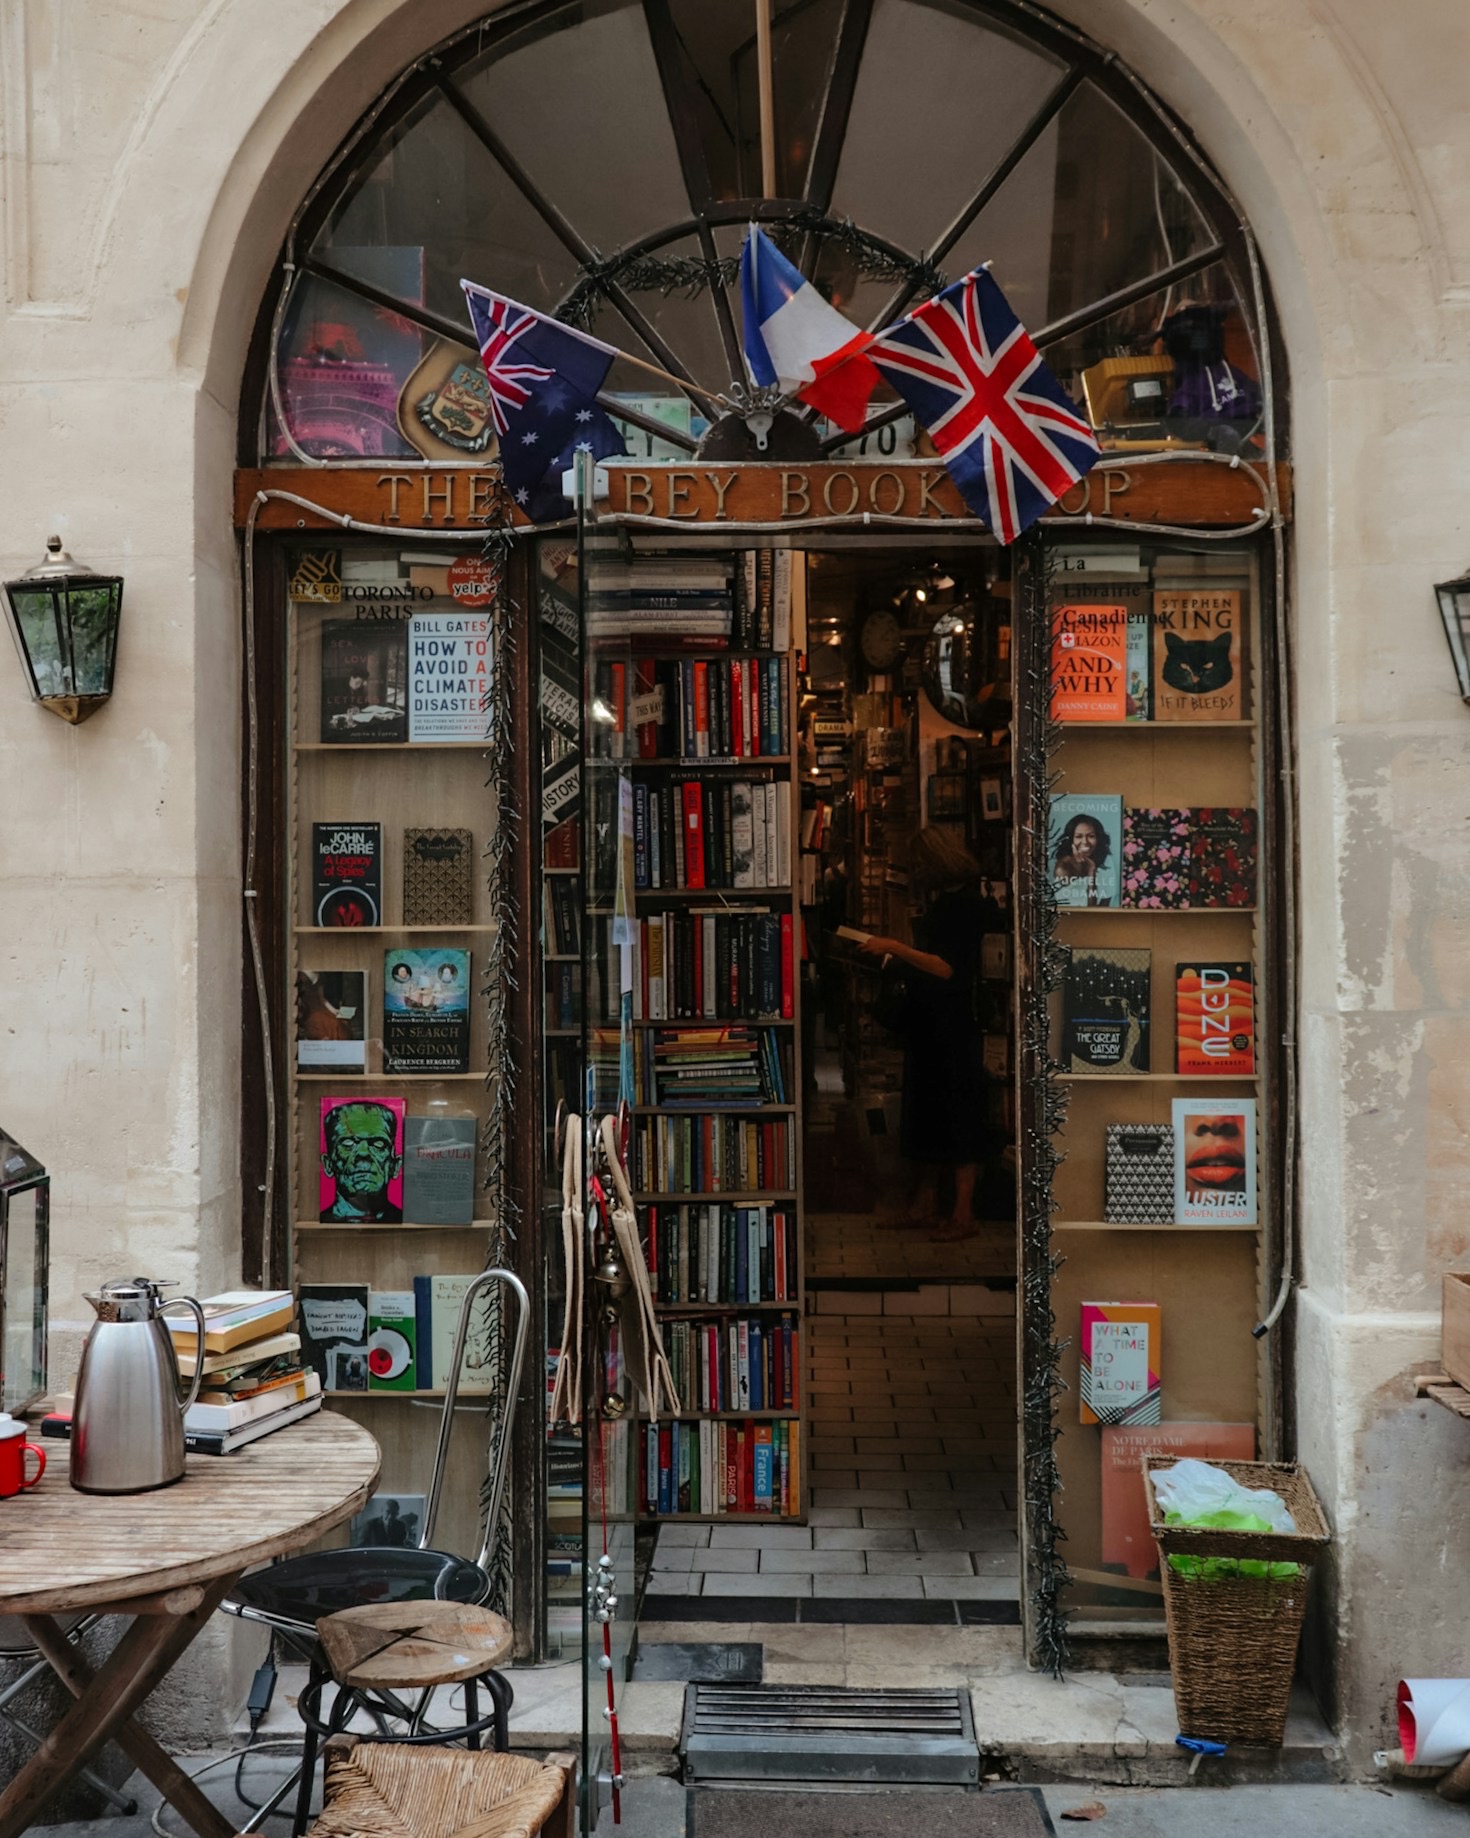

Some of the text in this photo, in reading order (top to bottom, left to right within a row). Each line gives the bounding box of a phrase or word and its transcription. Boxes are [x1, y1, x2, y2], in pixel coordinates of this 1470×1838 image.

[376, 474, 498, 521] THE
[623, 472, 738, 519] BEY
[452, 567, 496, 575] NOUS AIM
[1064, 558, 1086, 572] La
[324, 584, 341, 595] GO
[343, 586, 435, 602] TORONTO
[453, 581, 484, 597] yelp
[1064, 584, 1141, 598] Librairie
[650, 597, 678, 608] NILE
[1162, 598, 1232, 609] STEPHEN
[355, 605, 414, 621] PARIS
[1063, 609, 1167, 625] Canadienne
[1162, 610, 1232, 629] KING
[413, 621, 487, 633] BILL GATES
[1060, 621, 1118, 634] RESIST
[414, 640, 488, 656] HOW TO
[414, 660, 487, 675] AVOID A
[1063, 656, 1112, 673] AND
[414, 679, 487, 694] CLIMATE
[1058, 676, 1118, 693] WHY
[414, 699, 488, 712] DISASTER
[635, 701, 663, 717] THIS WAY
[1191, 695, 1235, 710] BLEEDS
[818, 723, 844, 731] DRAMA
[767, 795, 775, 824] Warning
[1052, 802, 1119, 813] BECOMING
[330, 832, 365, 844] JOHN
[767, 833, 775, 873] Anonymous
[335, 855, 372, 868] Legacy
[323, 865, 366, 879] of Spies
[1055, 876, 1116, 886] MICHELLE
[1061, 889, 1108, 899] OBAMA
[391, 1027, 460, 1038] IN SEARCH
[1076, 1032, 1121, 1043] THE GREAT
[391, 1043, 459, 1056] KINGDOM
[1089, 1043, 1121, 1055] GATSBY
[426, 1058, 461, 1066] BERGREEN
[1186, 1190, 1248, 1207] LUSTER
[1184, 1209, 1248, 1218] RAVEN LEILANI
[1093, 1325, 1138, 1337] WHAT
[1112, 1339, 1145, 1351] TIME
[1093, 1352, 1114, 1363] TO
[1094, 1366, 1110, 1377] BE
[1093, 1380, 1143, 1391] ALONE
[757, 1447, 769, 1492] France
[661, 1467, 669, 1489] France
[727, 1464, 737, 1495] PARIS
